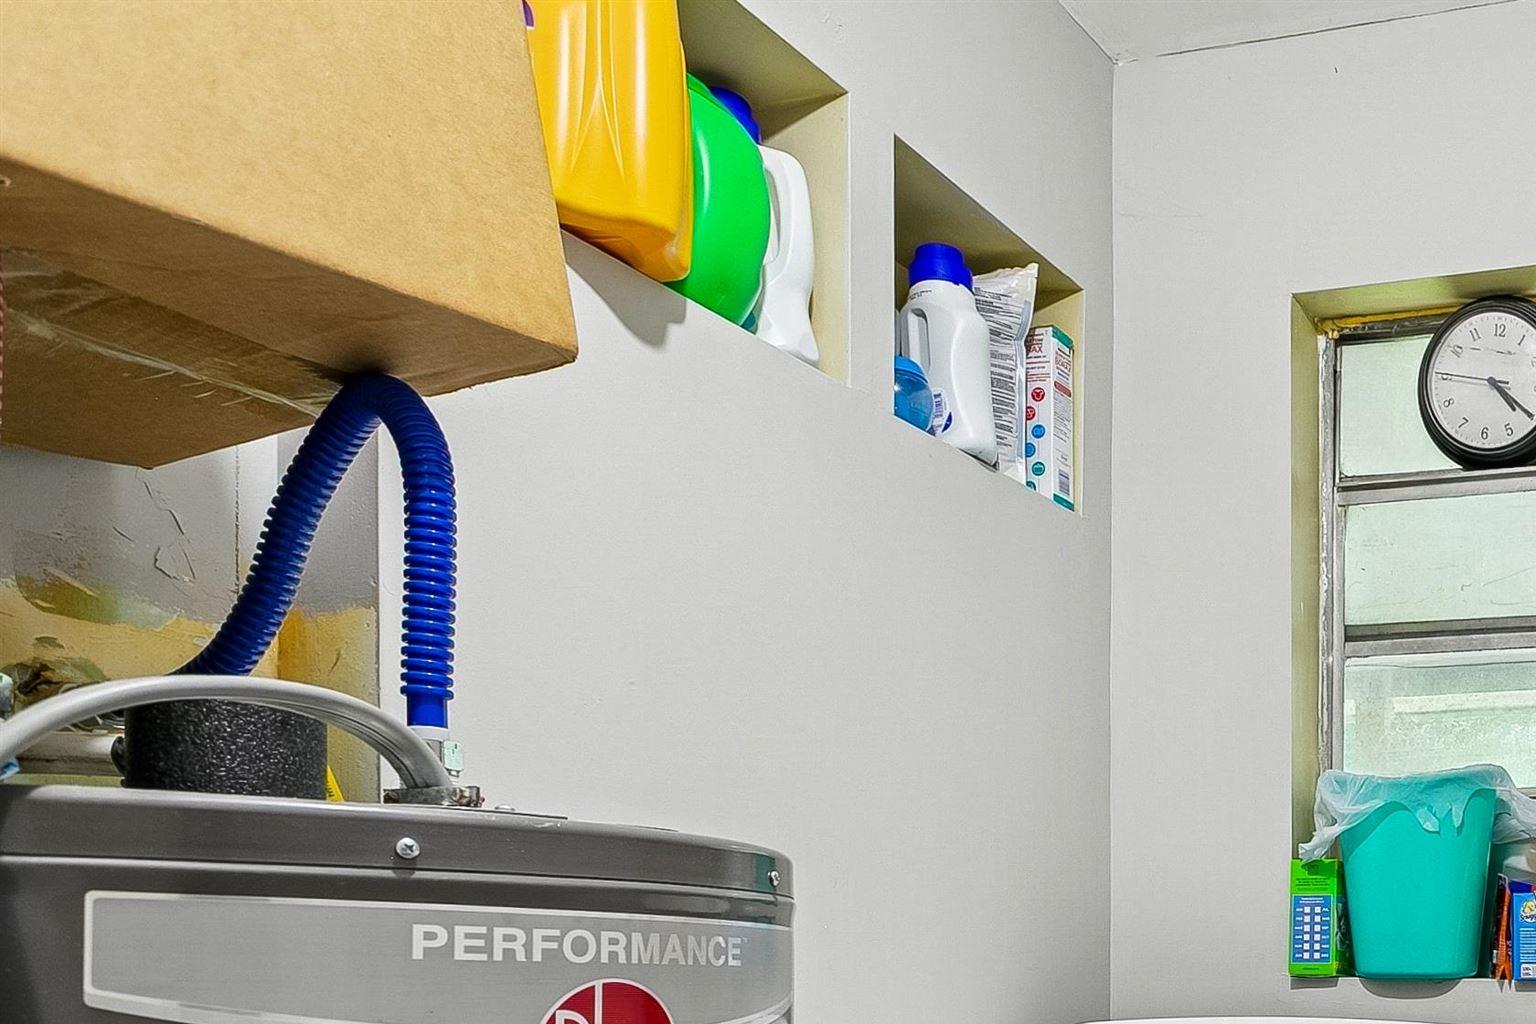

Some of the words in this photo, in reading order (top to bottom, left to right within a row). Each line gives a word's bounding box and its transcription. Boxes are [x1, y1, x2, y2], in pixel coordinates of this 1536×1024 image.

[1469, 327, 1482, 342] 11
[1493, 323, 1507, 338] 12
[1517, 334, 1526, 346] 1
[1450, 345, 1464, 358] 10
[1443, 397, 1454, 408] 8
[1457, 417, 1469, 429] 7
[1504, 422, 1514, 437] 5
[1480, 426, 1489, 440] 6
[411, 924, 743, 967] PERFORMANCE
